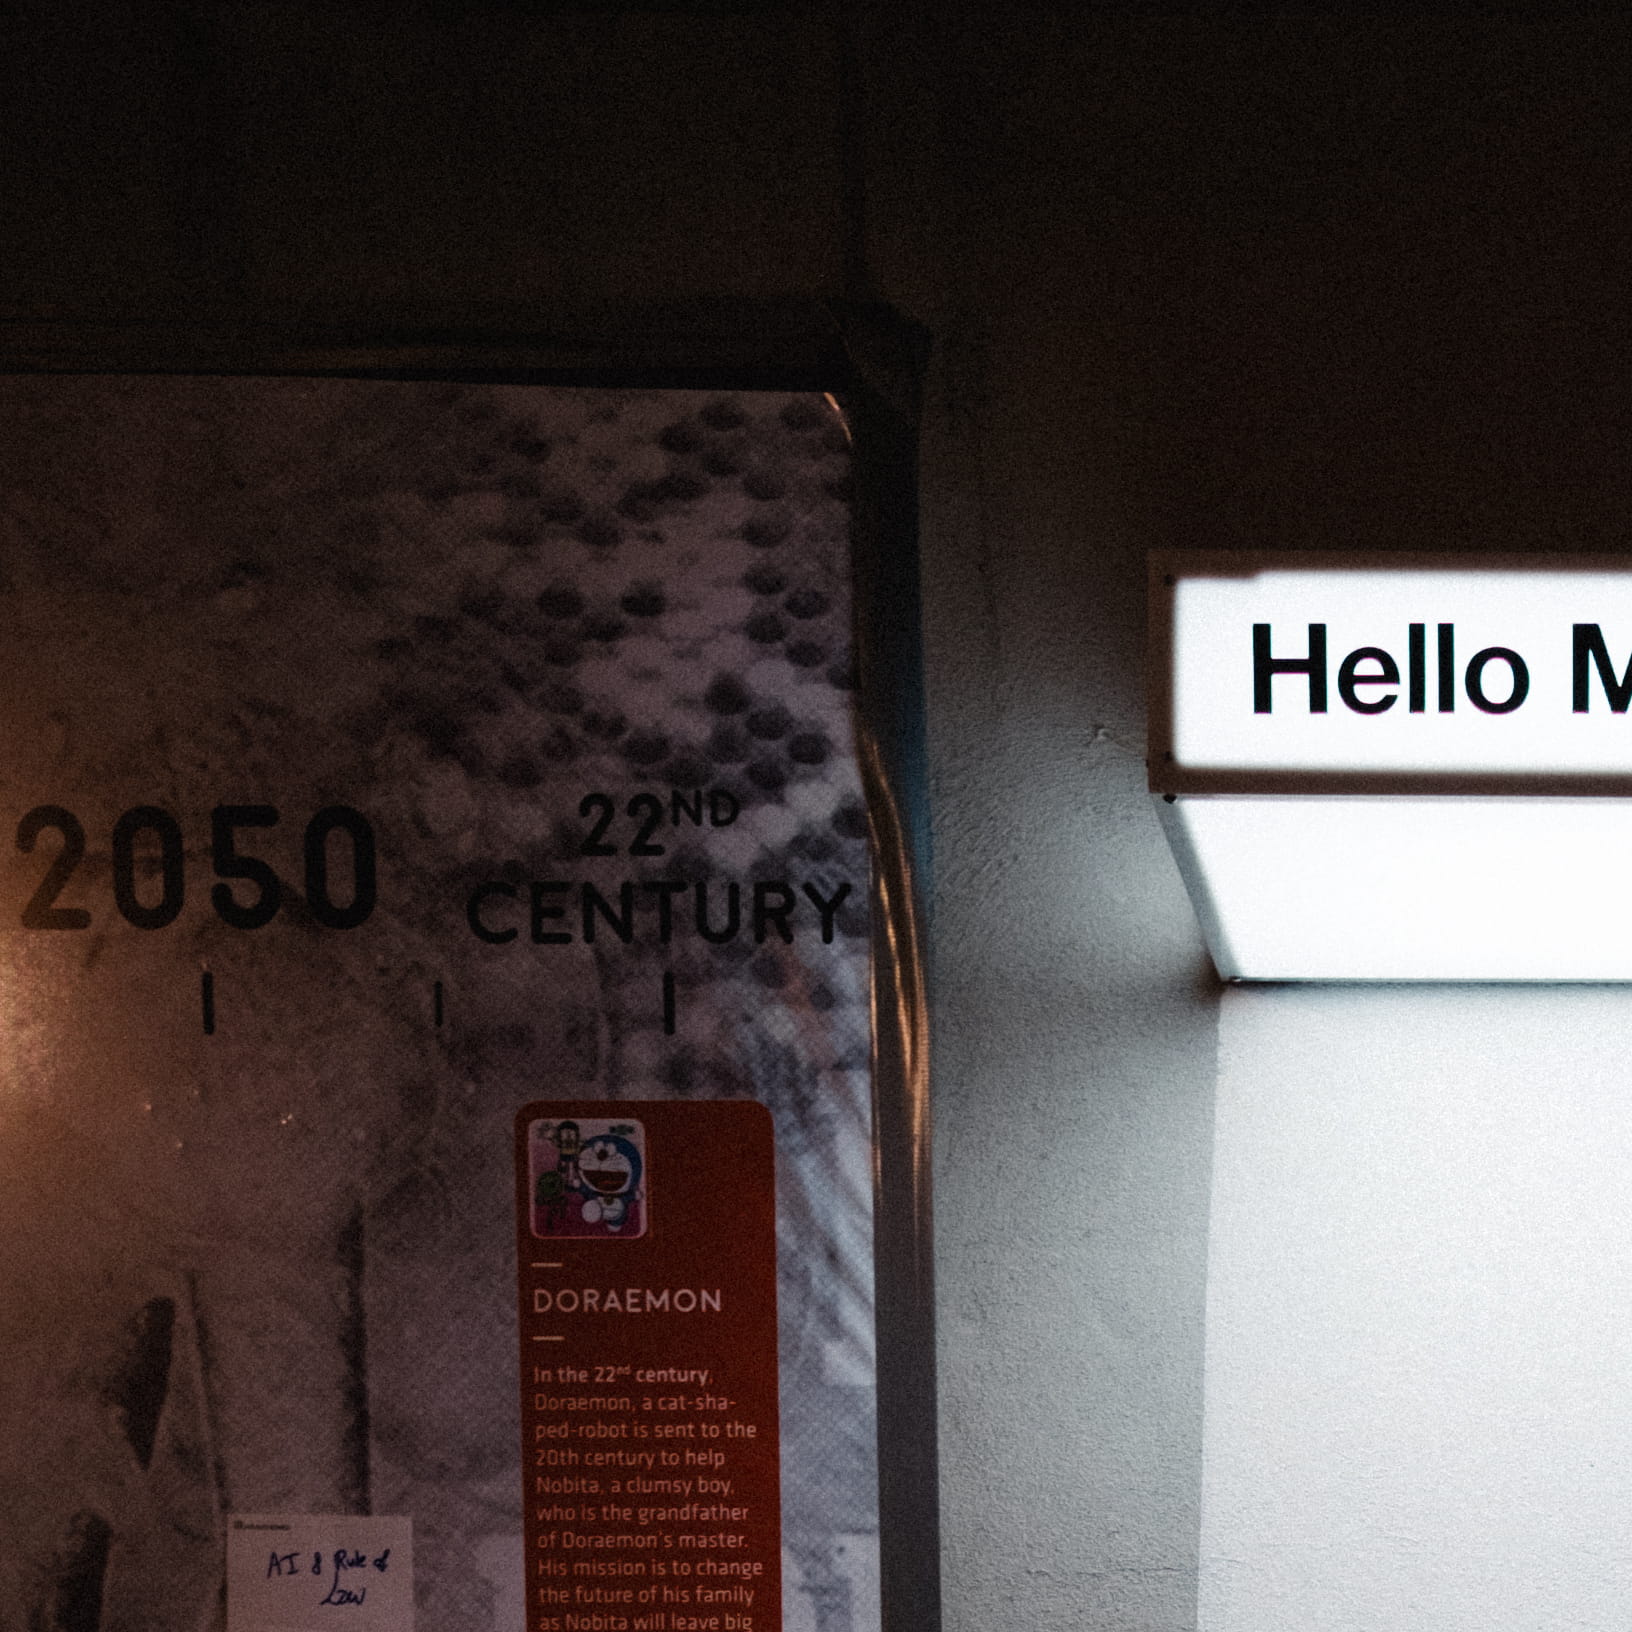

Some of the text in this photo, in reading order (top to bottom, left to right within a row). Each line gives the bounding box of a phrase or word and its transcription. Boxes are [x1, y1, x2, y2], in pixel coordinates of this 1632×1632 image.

[1251, 621, 1531, 715] Hello
[578, 788, 742, 857] 22ND
[14, 803, 379, 933] 2050
[466, 880, 854, 947] CENTURY
[533, 1288, 722, 1313] DORAEMON
[534, 1366, 553, 1383] In
[557, 1366, 589, 1383] the
[594, 1366, 632, 1383] 22nd
[641, 1397, 653, 1411] a
[656, 1393, 737, 1411] cat-sha-
[535, 1421, 758, 1442] ped-robot is sent to the
[537, 1448, 726, 1470] 20th century to help
[610, 1480, 622, 1493] a
[625, 1476, 693, 1497] clumsy
[536, 1503, 751, 1525] who is the grandfather
[538, 1531, 556, 1548] of
[562, 1531, 673, 1548] Doraemon's
[267, 1552, 299, 1578] AI
[538, 1558, 765, 1580] His mission is to change
[539, 1586, 756, 1607] the future of his family
[539, 1617, 561, 1631] as
[565, 1613, 629, 1631] Nobita
[632, 1613, 666, 1631] will
[670, 1613, 721, 1631] leave
